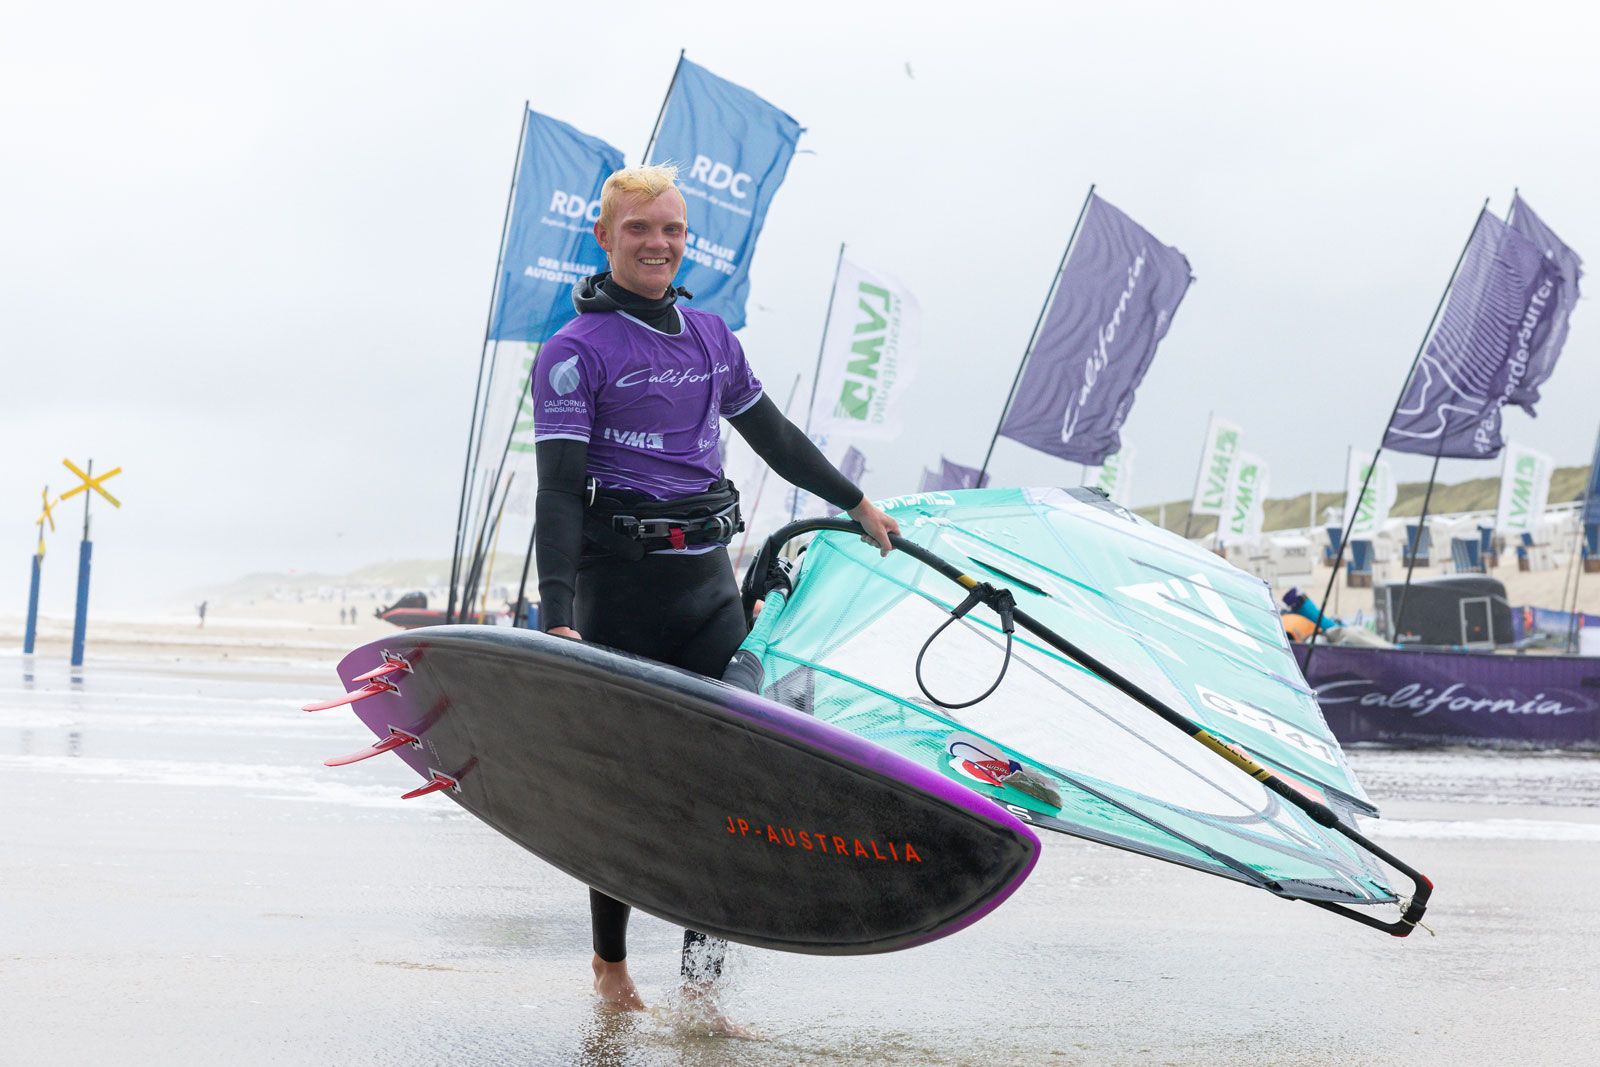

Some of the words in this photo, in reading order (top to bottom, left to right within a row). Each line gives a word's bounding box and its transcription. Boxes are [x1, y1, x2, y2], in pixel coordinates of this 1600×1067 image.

[690, 154, 752, 199] RDC
[1061, 247, 1148, 443] California
[544, 399, 586, 407] CALIFORNIA
[1202, 454, 1232, 508] LVM
[1507, 477, 1533, 528] LVM
[1231, 486, 1252, 534] LVM
[1314, 679, 1577, 718] California
[726, 815, 922, 863] JP-AUSTRALIA
